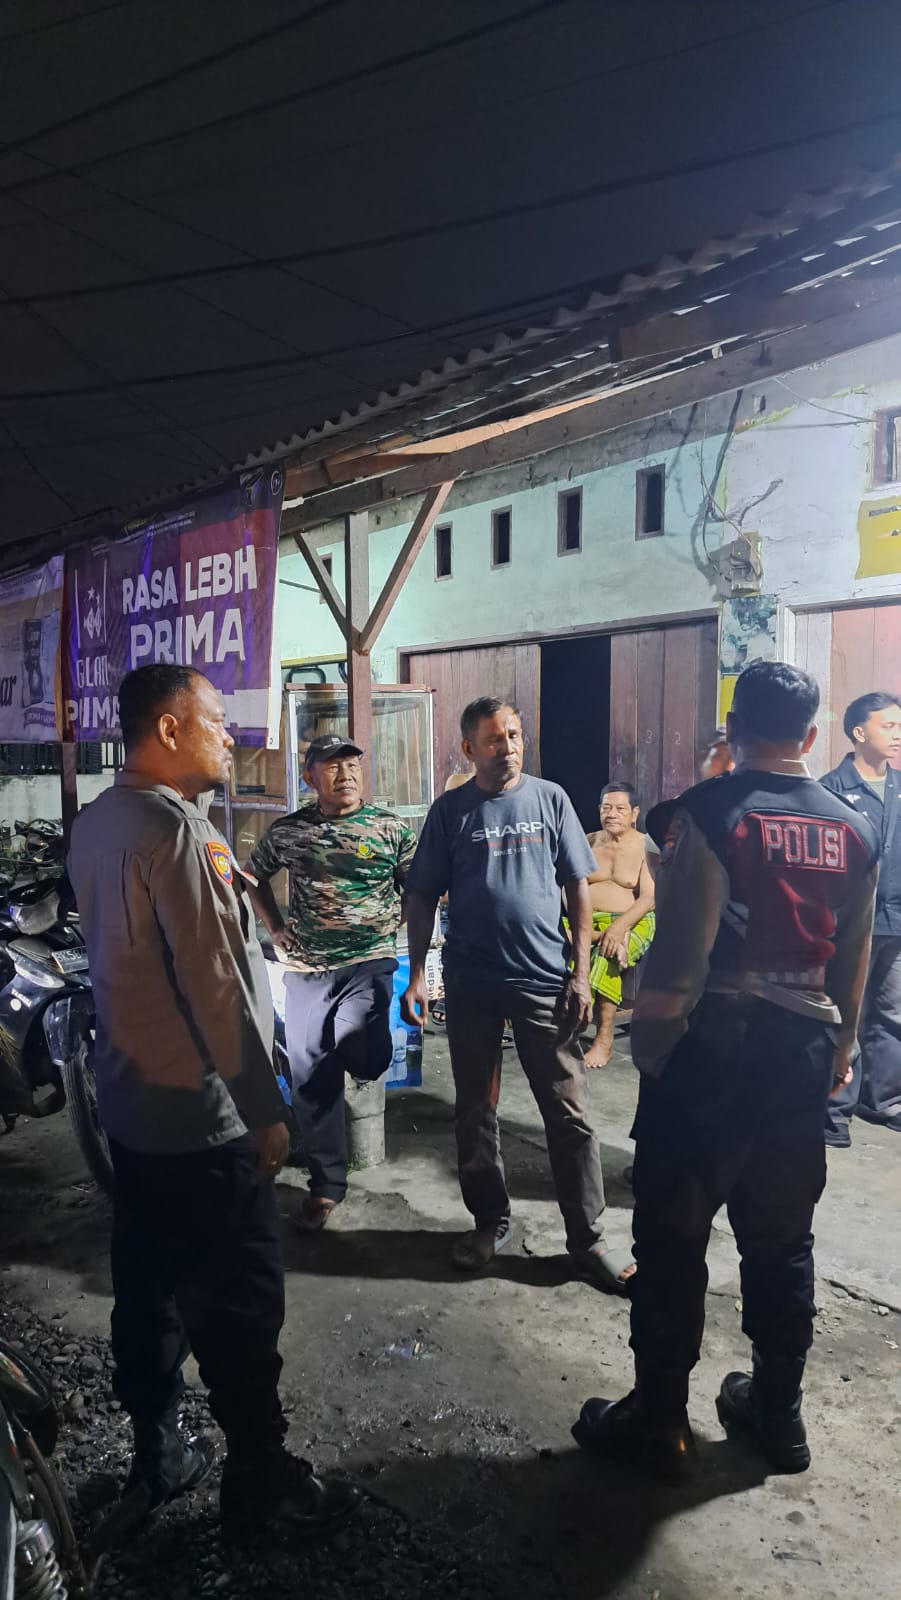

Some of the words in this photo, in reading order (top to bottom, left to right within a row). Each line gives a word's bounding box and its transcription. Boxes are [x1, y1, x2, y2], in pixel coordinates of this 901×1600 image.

[122, 566, 179, 615] RASA
[184, 544, 258, 602] LEBIH
[130, 608, 246, 670] PRIMA
[64, 695, 121, 730] PIMA
[471, 821, 545, 842] SHARP
[764, 821, 846, 869] POLISI
